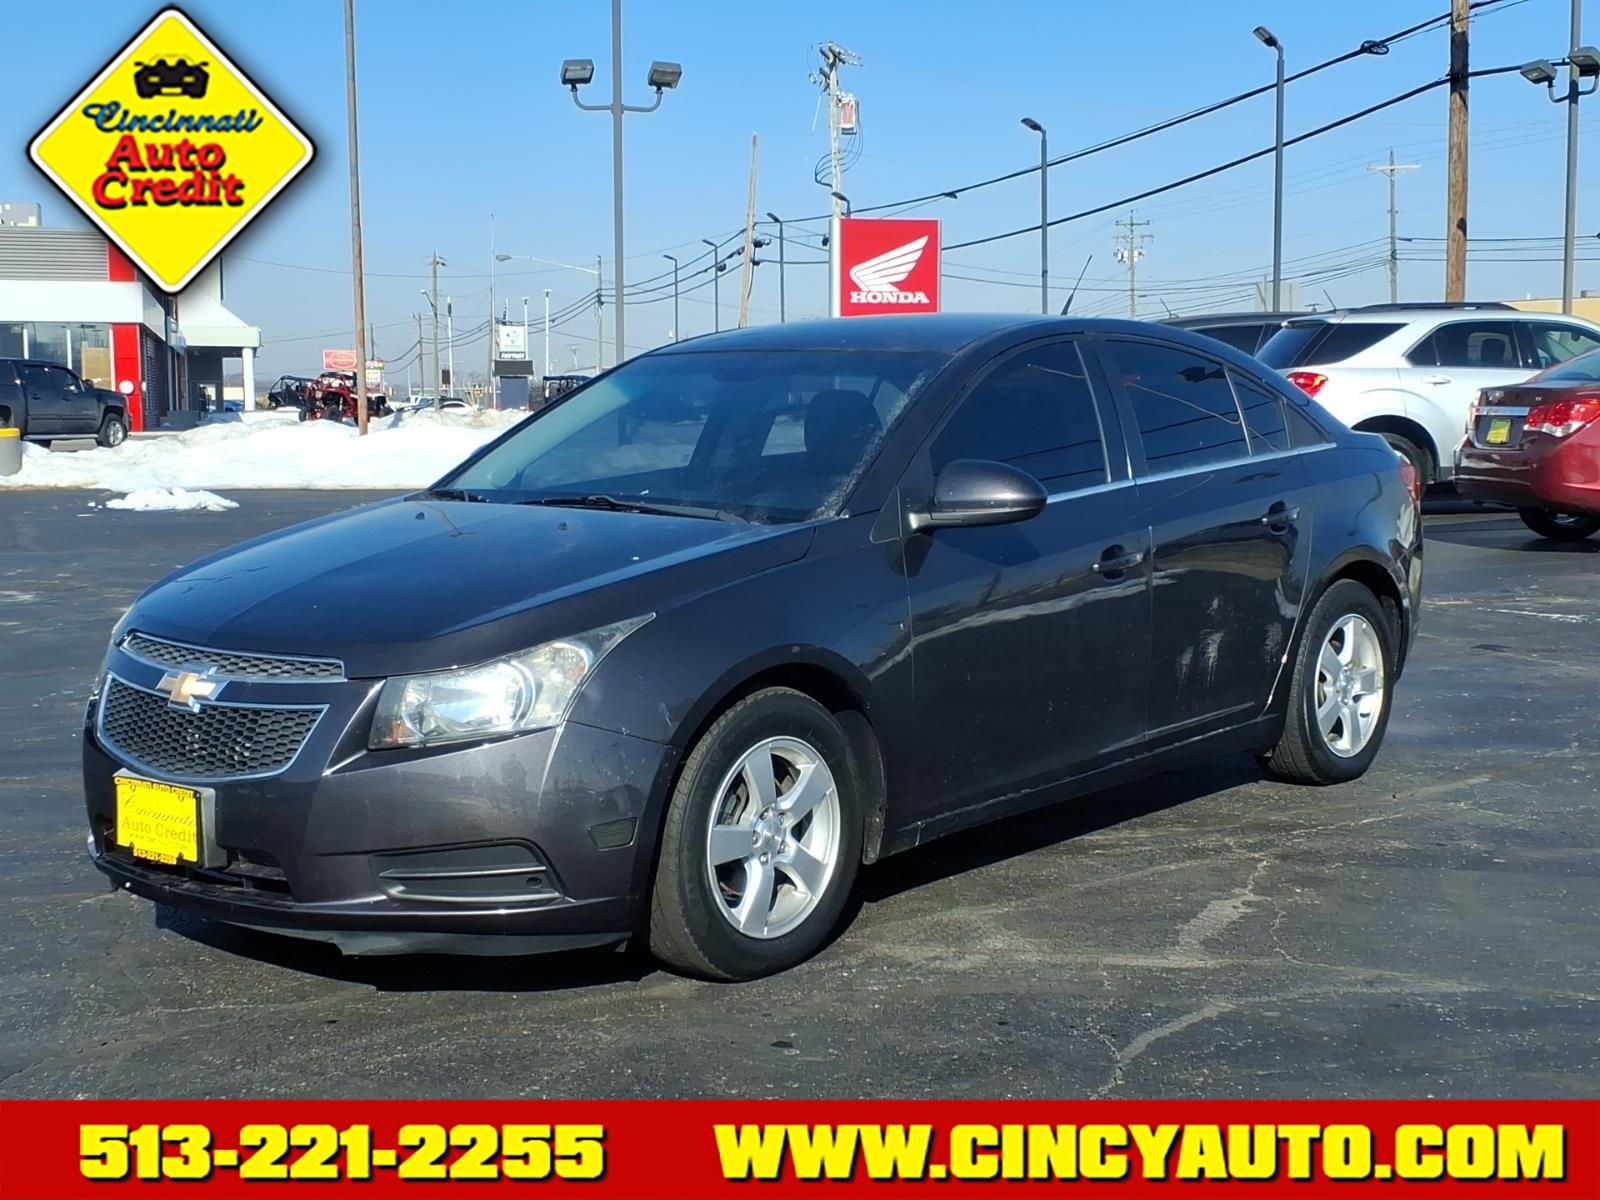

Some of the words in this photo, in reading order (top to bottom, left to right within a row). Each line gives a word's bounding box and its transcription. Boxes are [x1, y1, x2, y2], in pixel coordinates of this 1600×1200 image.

[849, 291, 930, 304] HONDA
[122, 815, 151, 834] Auto
[155, 822, 196, 843] Credit
